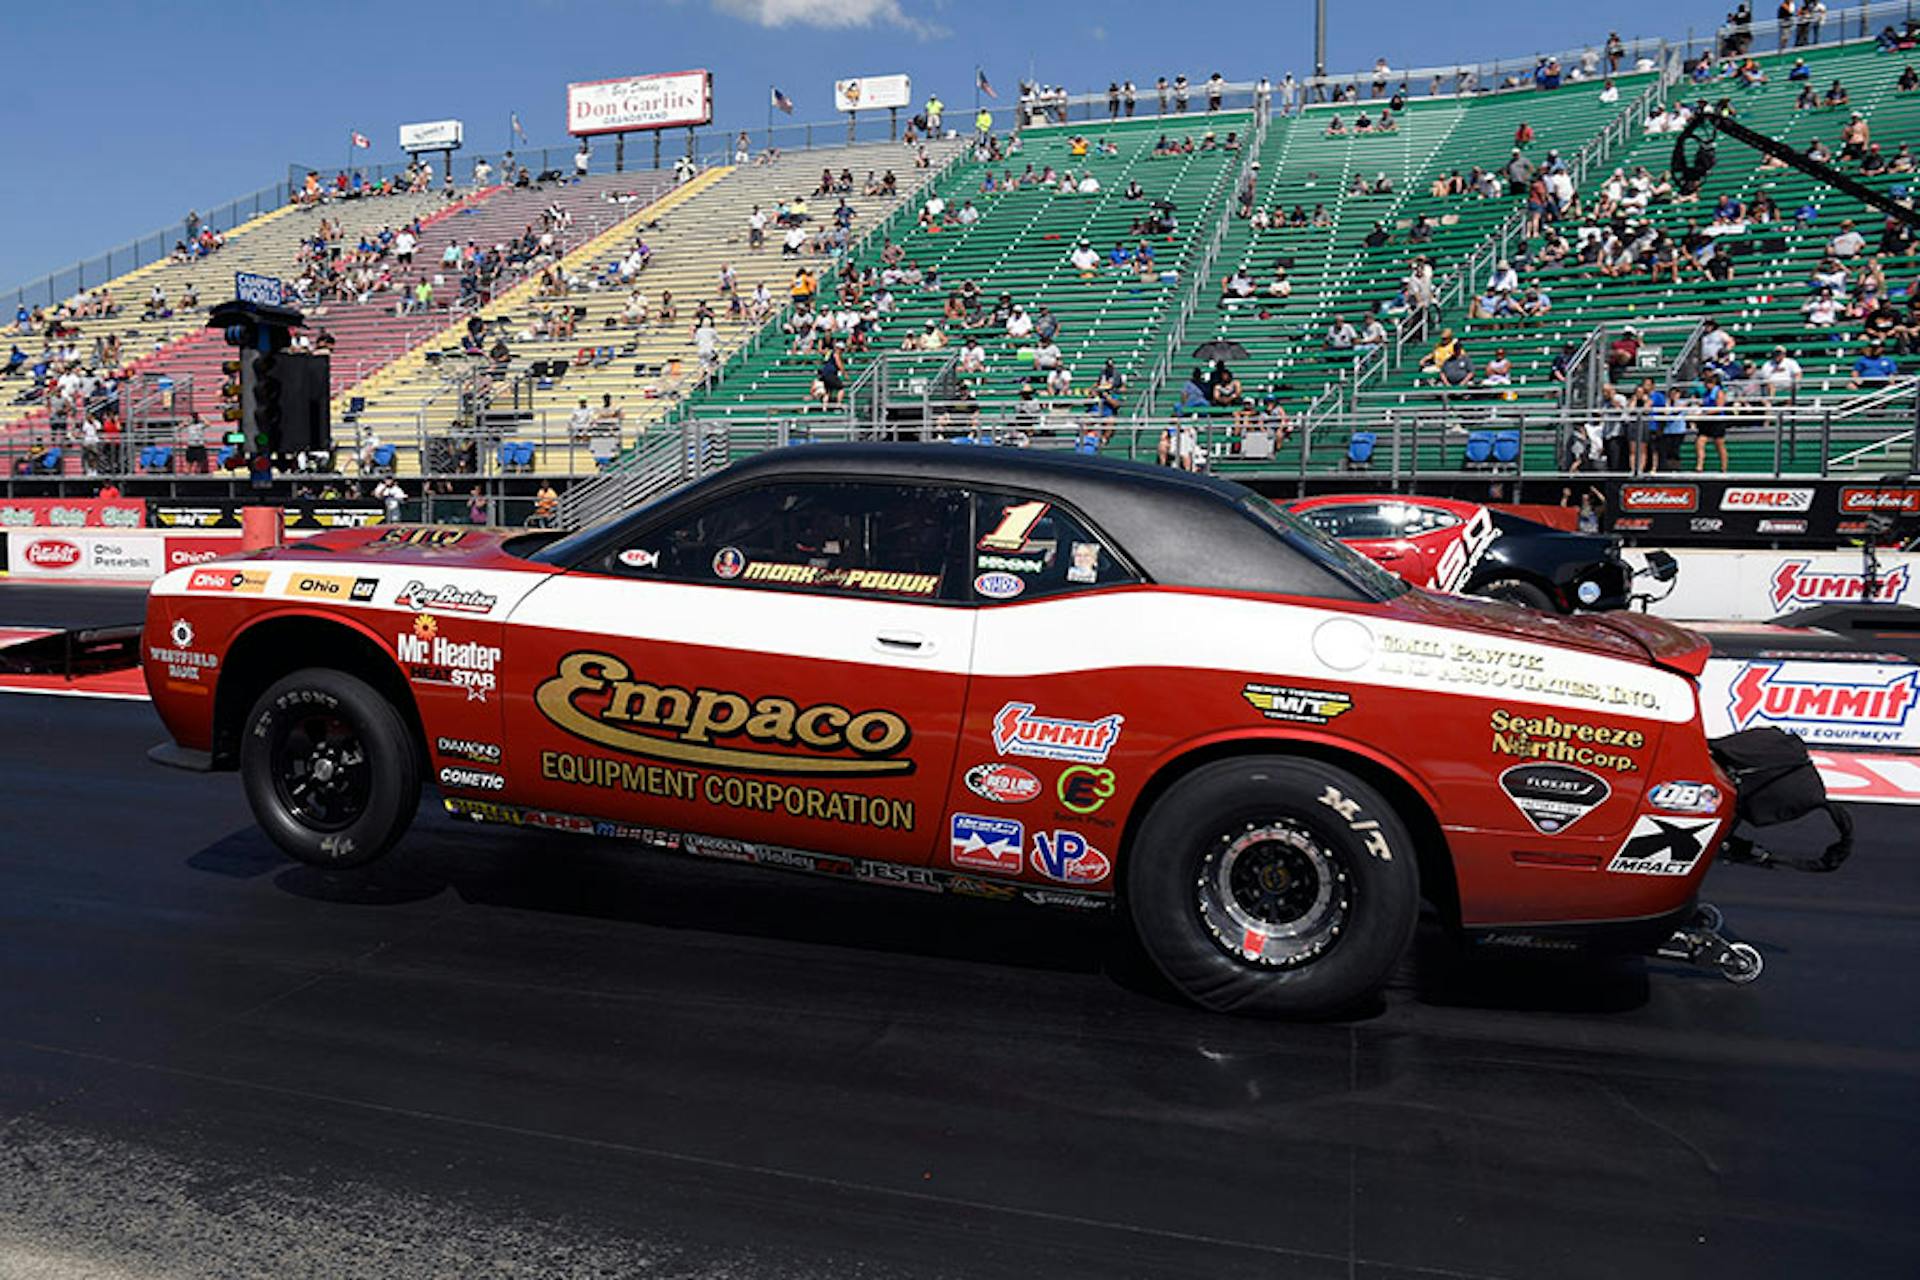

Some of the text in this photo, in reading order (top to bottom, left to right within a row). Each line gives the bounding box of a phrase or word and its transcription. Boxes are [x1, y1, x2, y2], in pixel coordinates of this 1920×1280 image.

[577, 101, 617, 118] Don
[1727, 492, 1790, 506] COMP
[980, 501, 1048, 550] 1
[94, 544, 122, 555] Ohio
[94, 557, 149, 568] Peterbilt
[193, 574, 225, 587] Ohio
[299, 579, 340, 594] Ohio
[397, 633, 501, 671] Mr. Heater
[536, 651, 914, 776] Empaco
[1272, 695, 1323, 714] M/T
[1490, 709, 1644, 748] Seabreeze
[1813, 727, 1902, 742] EQUIPMENT
[438, 737, 500, 758] DIAMOND
[440, 767, 505, 790] COMETIC
[541, 751, 914, 831] EQUIPMENT CORPORATION
[1318, 785, 1393, 862] M/T
[1034, 832, 1088, 881] VP
[1610, 859, 1690, 874] IMPACT
[856, 860, 937, 887] JESEL
